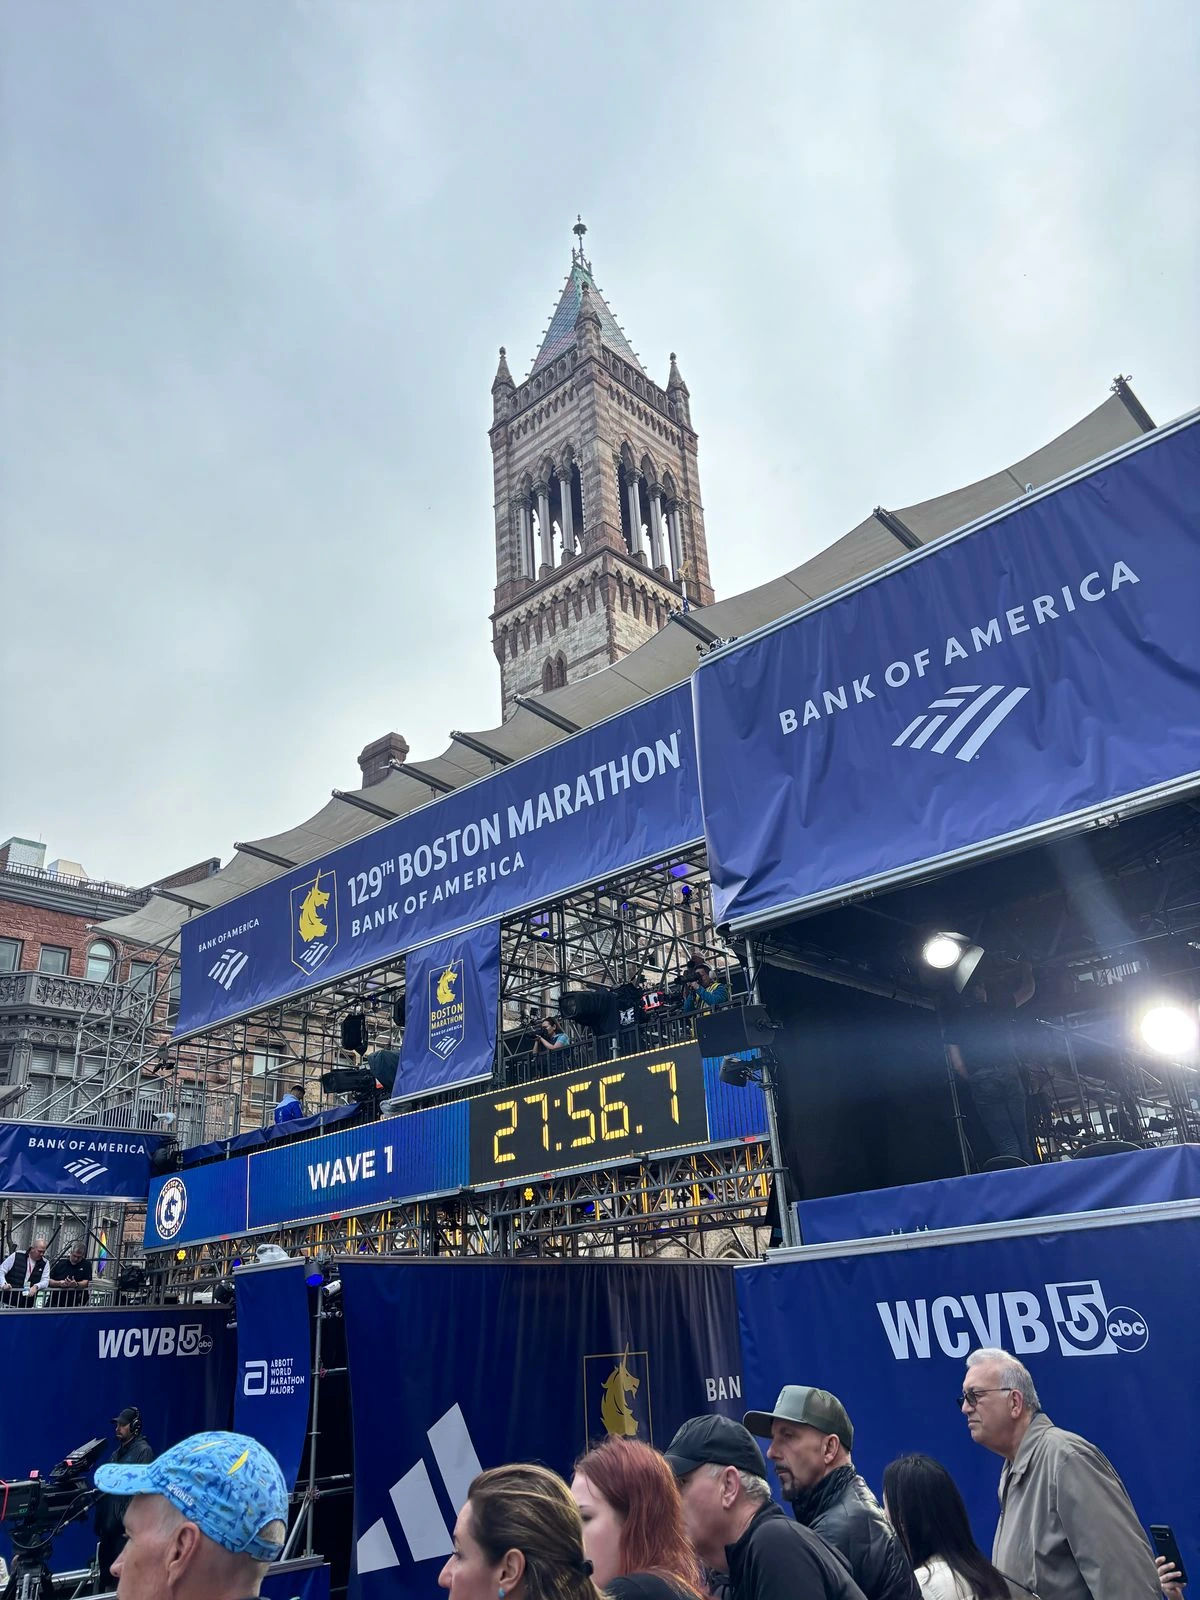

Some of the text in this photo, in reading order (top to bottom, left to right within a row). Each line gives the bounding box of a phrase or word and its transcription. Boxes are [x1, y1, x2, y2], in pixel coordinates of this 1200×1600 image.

[778, 560, 1140, 735] BANK OF AMERICA
[347, 731, 681, 908] 129TH BOSTON MARATHON
[351, 851, 525, 938] BANK OF AMERICA
[198, 918, 260, 953] BANK OF AMERICA
[431, 1002, 463, 1022] BOSTON
[431, 1014, 463, 1030] MARATHON
[431, 1030, 441, 1038] BANK
[446, 1024, 463, 1033] AMERICA
[28, 1137, 145, 1154] BANK OF AMERICA
[307, 1145, 393, 1191] WAVE 1
[876, 1280, 1146, 1360] WCVB 5 abc
[98, 1324, 212, 1358] WCVB 5 abc
[270, 1358, 294, 1368] ABBOTT
[270, 1367, 292, 1376] WORLD
[269, 1385, 295, 1395] MAJORS
[270, 1376, 305, 1386] MARATHON
